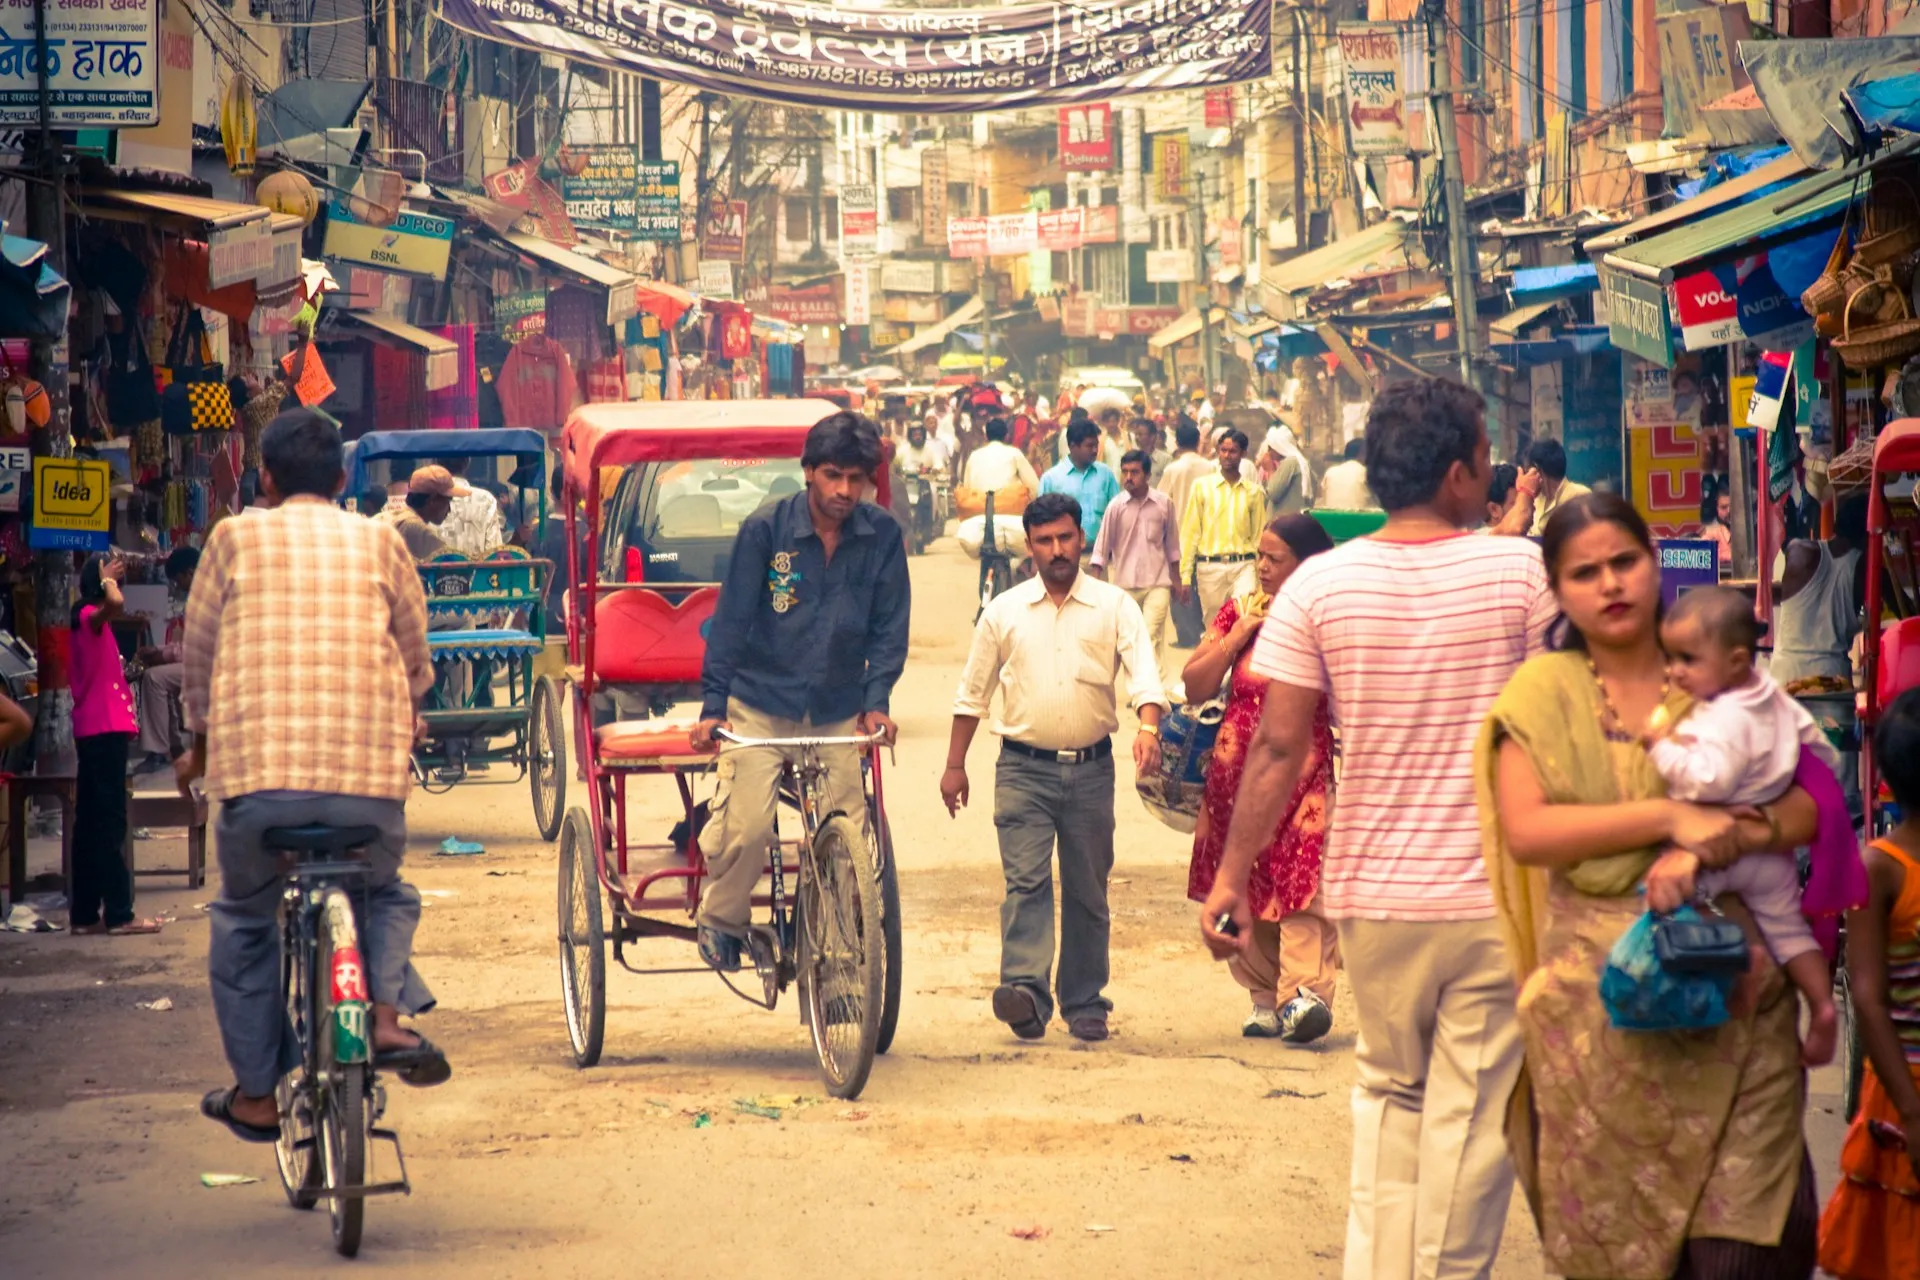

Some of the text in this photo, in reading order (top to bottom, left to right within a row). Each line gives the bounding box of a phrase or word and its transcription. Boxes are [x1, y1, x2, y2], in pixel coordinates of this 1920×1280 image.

[72, 40, 147, 81] हाक
[412, 216, 447, 235] PCO
[370, 249, 401, 264] BSNL
[1663, 549, 1712, 569] SERVICE
